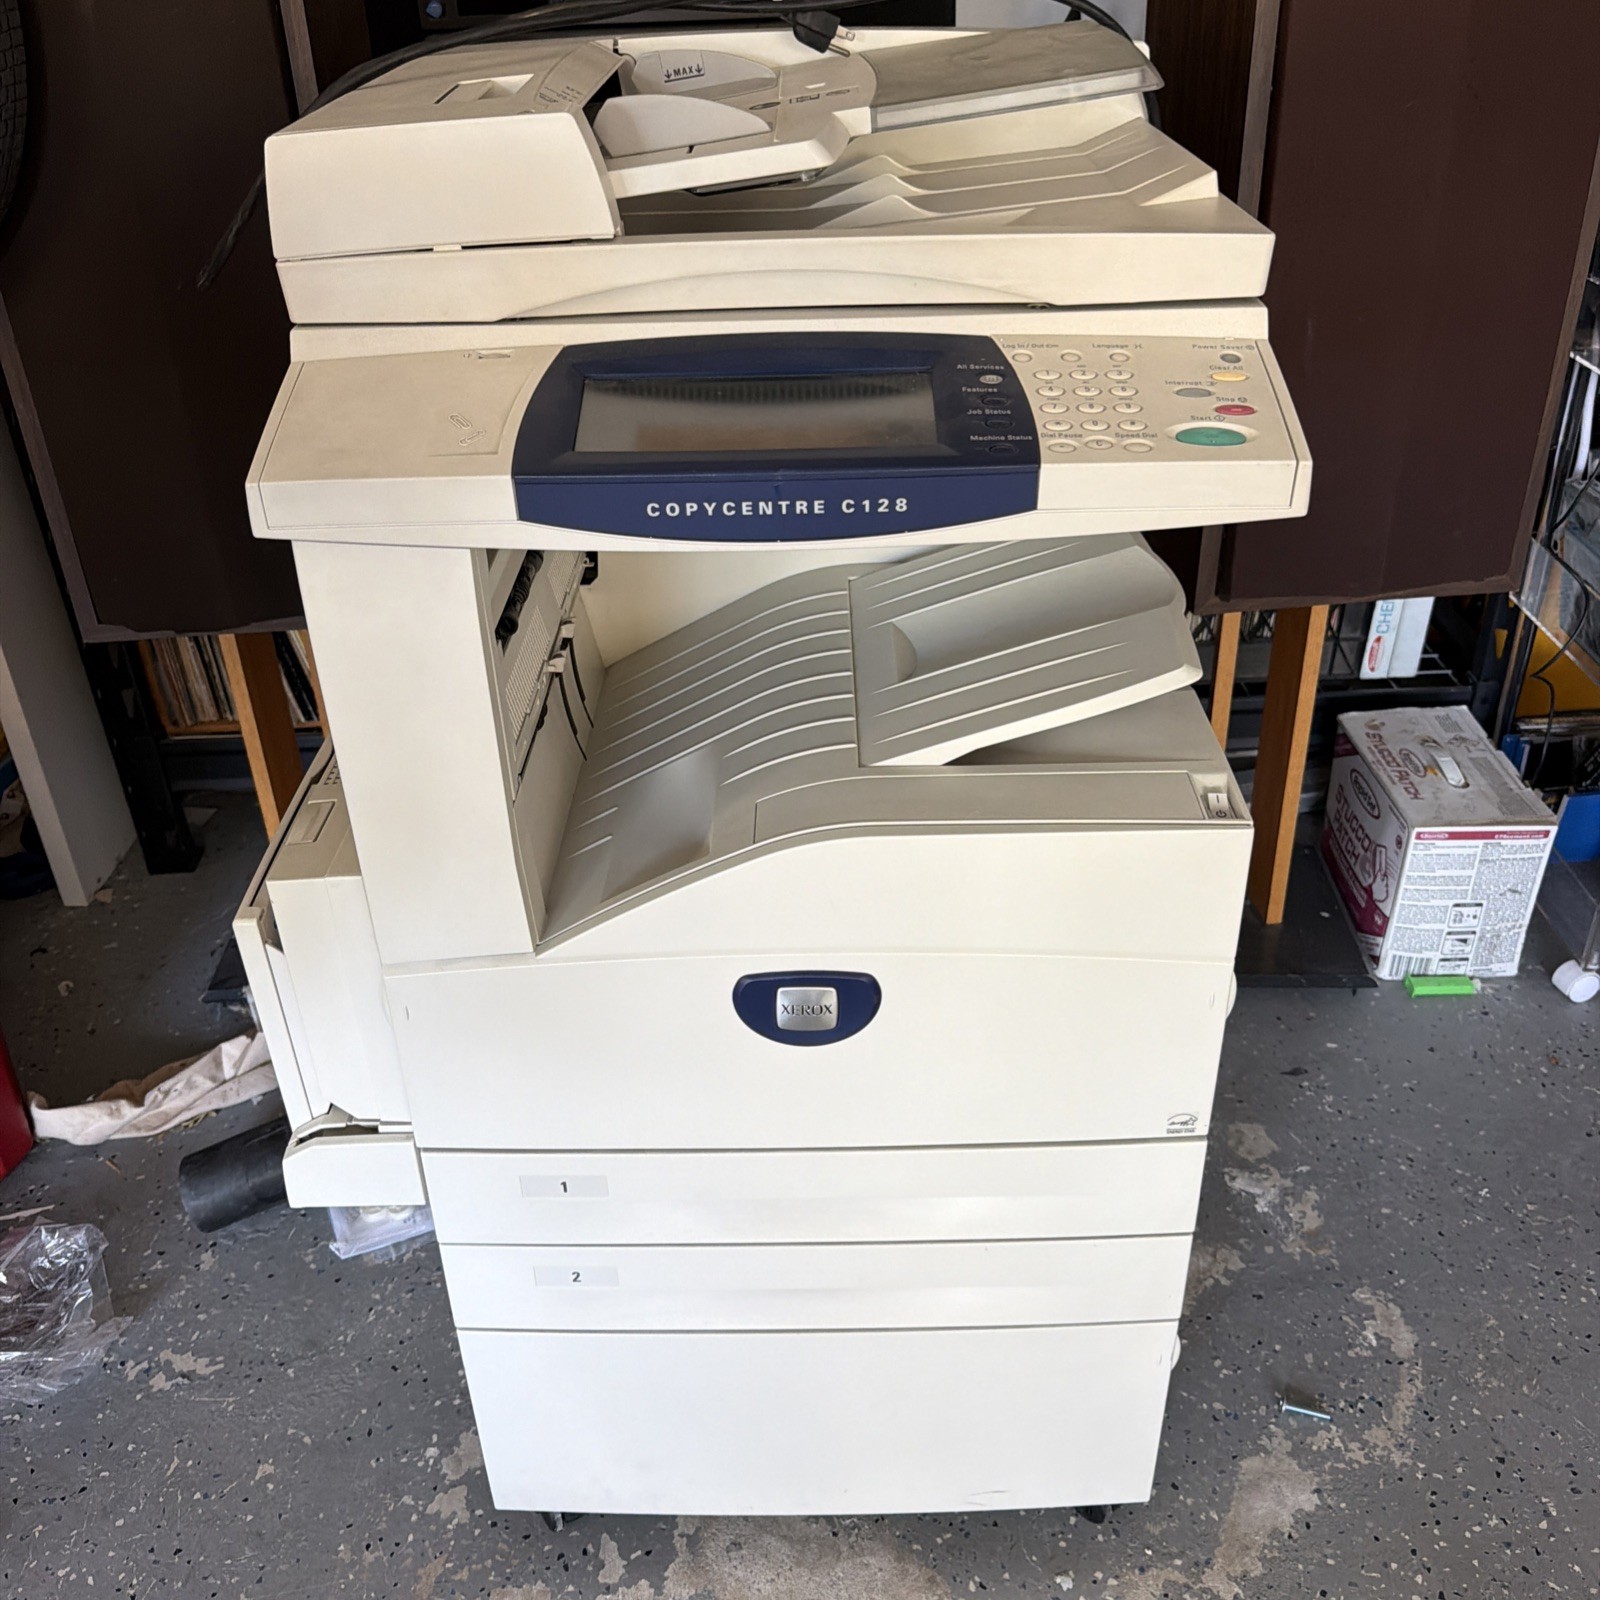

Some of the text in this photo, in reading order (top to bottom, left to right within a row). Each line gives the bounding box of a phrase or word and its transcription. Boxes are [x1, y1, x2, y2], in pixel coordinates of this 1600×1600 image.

[673, 66, 694, 77] MAX
[647, 498, 908, 517] COPYCENTRE C128
[1336, 784, 1372, 853] STUCCO
[1333, 808, 1360, 866] PATCH
[781, 1003, 832, 1015] XEROX
[560, 1181, 568, 1193] 1
[571, 1272, 582, 1283] 2
